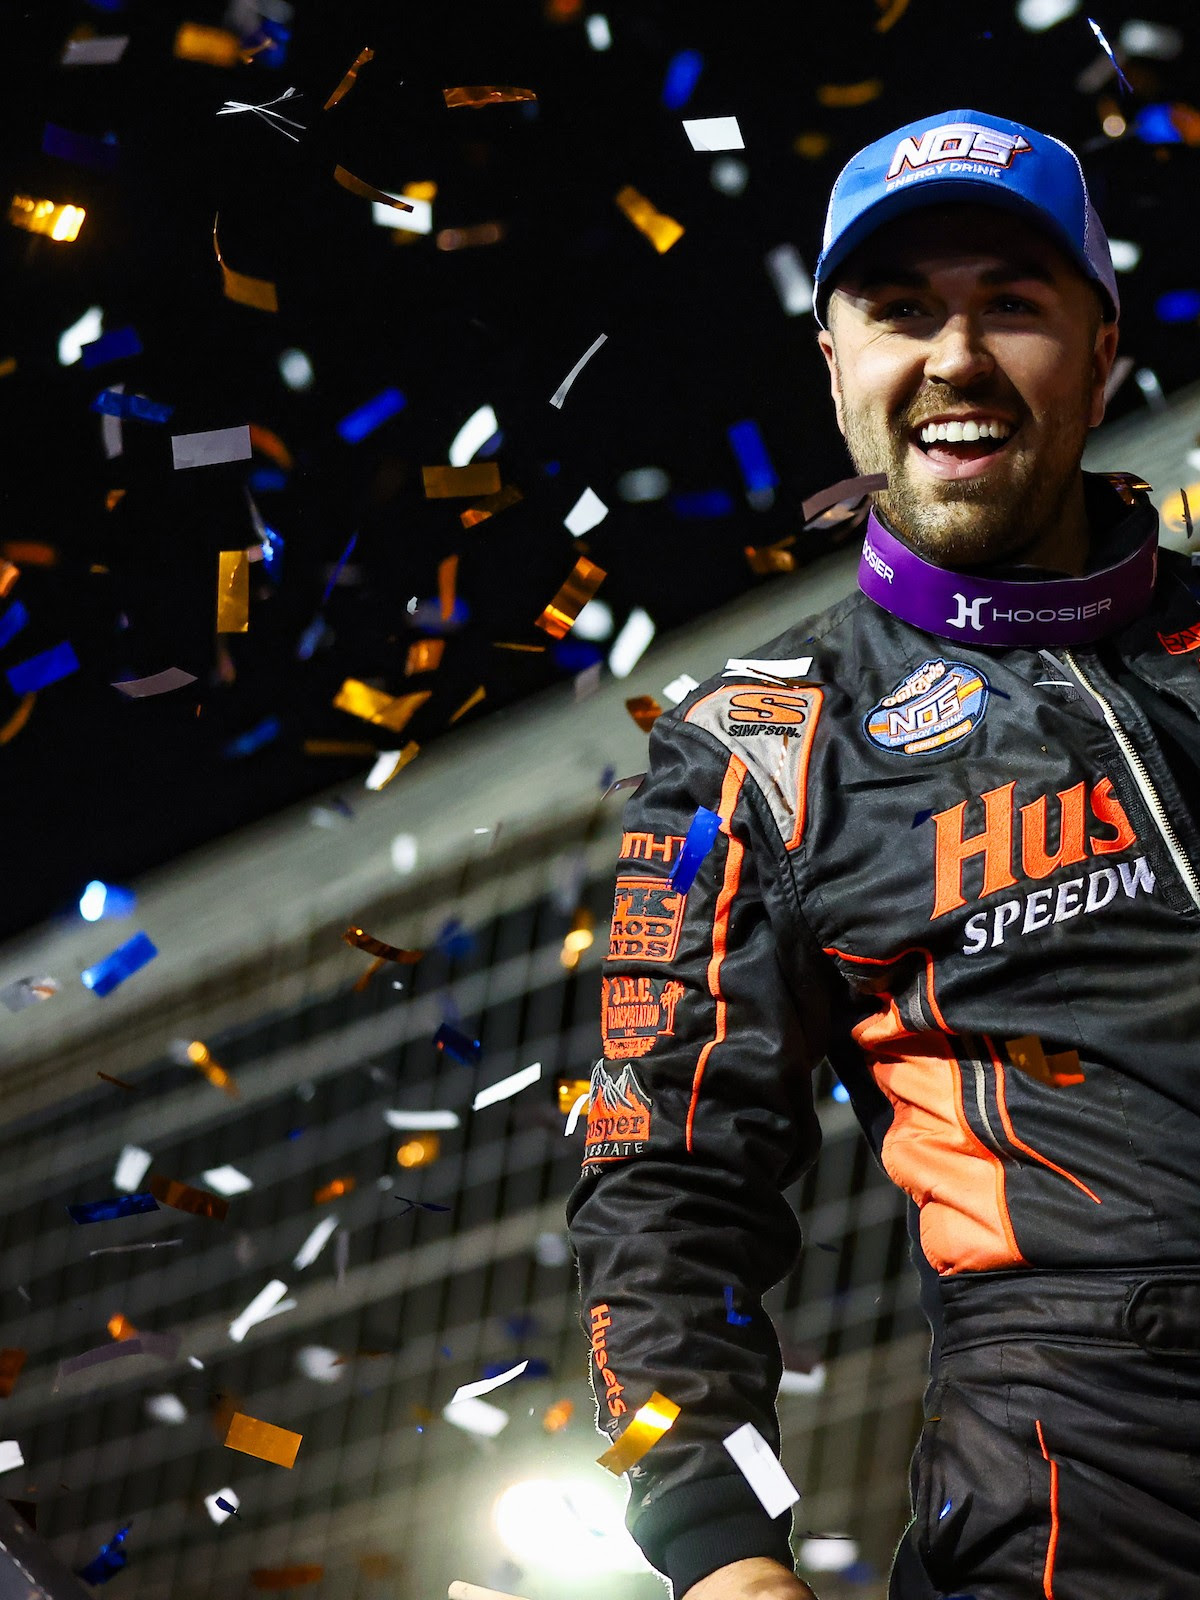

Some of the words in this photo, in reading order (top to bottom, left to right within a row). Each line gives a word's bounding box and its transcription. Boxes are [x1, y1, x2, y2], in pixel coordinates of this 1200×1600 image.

[885, 122, 1033, 181] NOS
[886, 164, 946, 192] ENERGY
[950, 163, 1001, 178] DRINK
[992, 598, 1112, 623] HOOSIER
[887, 673, 964, 738] NOS
[889, 728, 932, 745] ENERGY
[933, 711, 965, 733] DRINK
[589, 1142, 643, 1156] ESTATE
